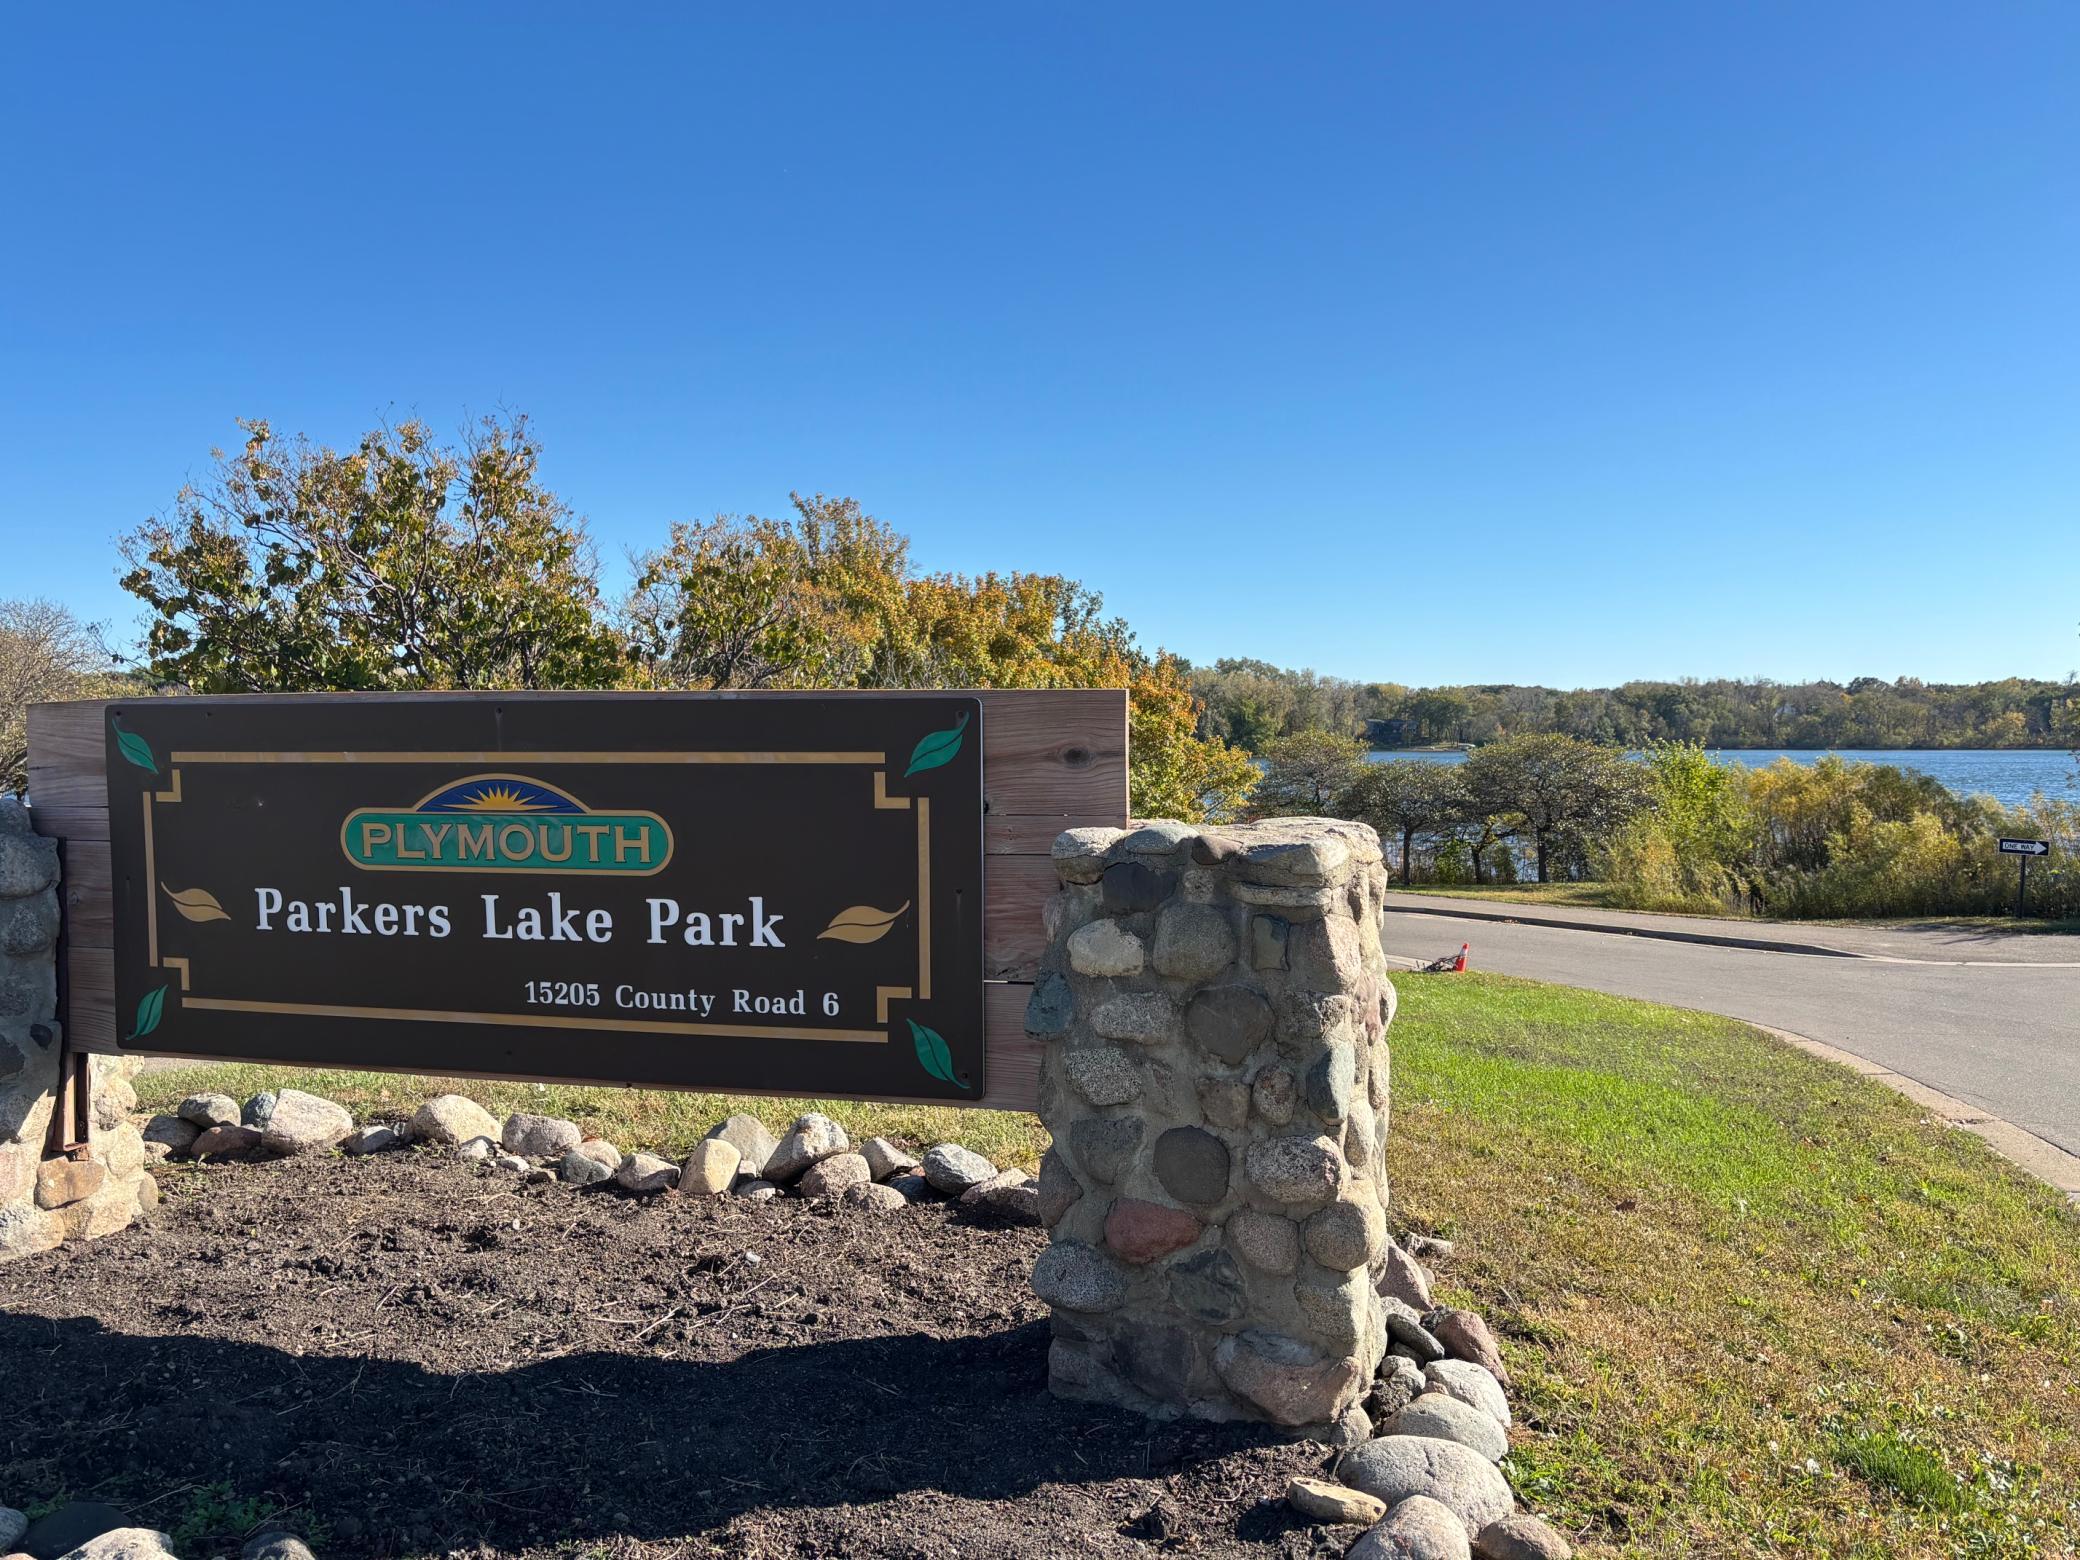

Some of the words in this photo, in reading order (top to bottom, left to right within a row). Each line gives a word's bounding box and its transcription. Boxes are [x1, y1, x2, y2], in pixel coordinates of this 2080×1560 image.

[361, 822, 652, 864] PLYMOUTH
[2004, 842, 2018, 850] ONE
[254, 886, 451, 938] Parkers
[480, 891, 613, 943] Lake
[645, 896, 786, 948] Park
[524, 981, 600, 1006] 15205
[615, 984, 716, 1018] County
[732, 989, 806, 1015] Road
[822, 992, 840, 1016] 6
